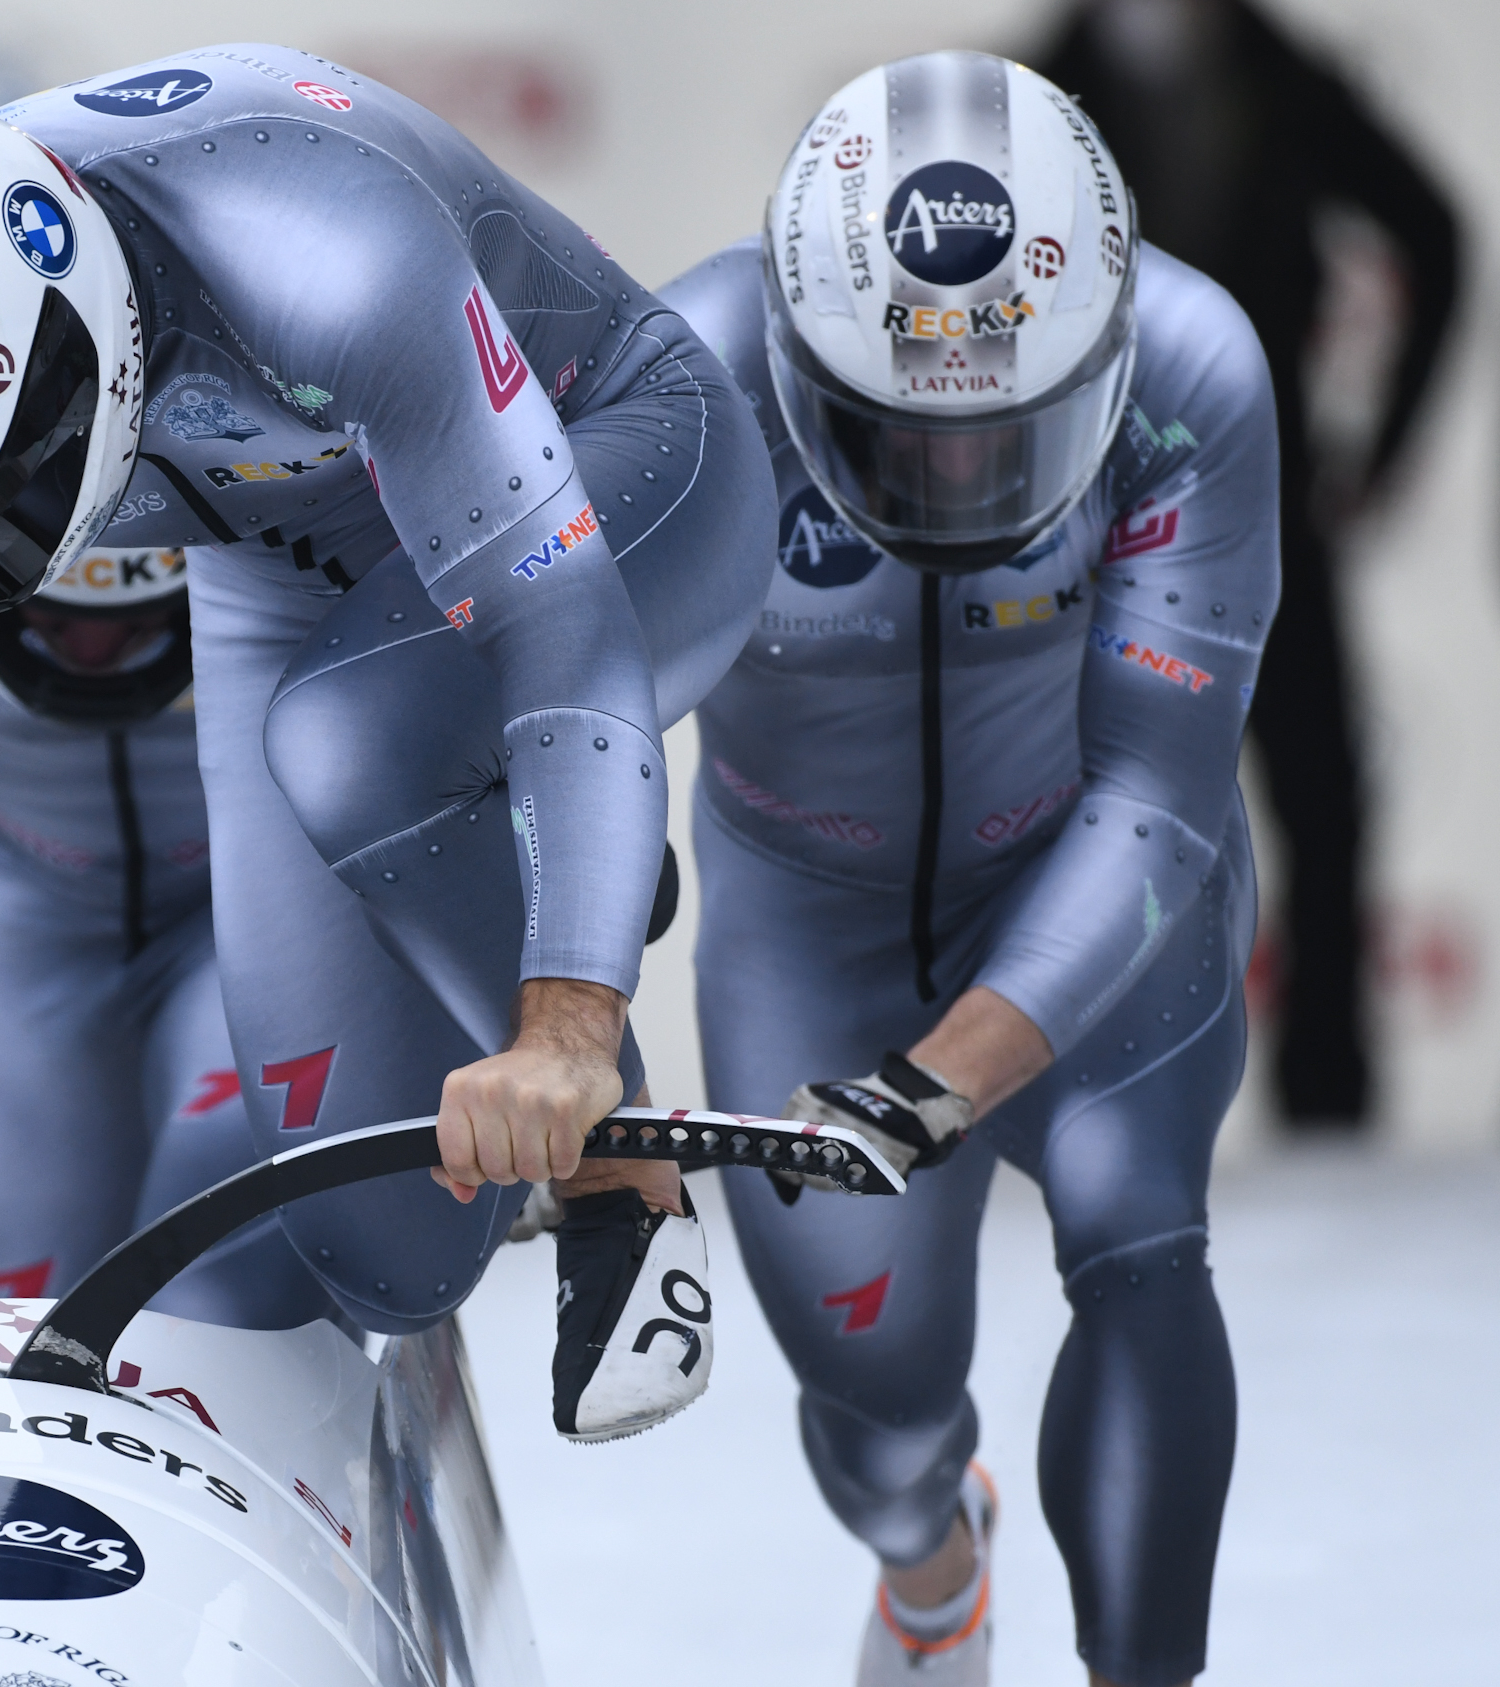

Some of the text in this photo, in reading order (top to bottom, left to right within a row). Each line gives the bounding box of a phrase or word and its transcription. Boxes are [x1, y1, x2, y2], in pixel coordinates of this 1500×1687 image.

[782, 156, 819, 304] Binders
[842, 171, 873, 291] Binders
[887, 188, 1012, 253] Arčers
[201, 373, 232, 395] RIGA
[911, 373, 1000, 392] LATVIJA
[760, 610, 896, 641] Binders
[528, 878, 540, 940] LATVIJAS
[52, 1643, 132, 1687] RIG
